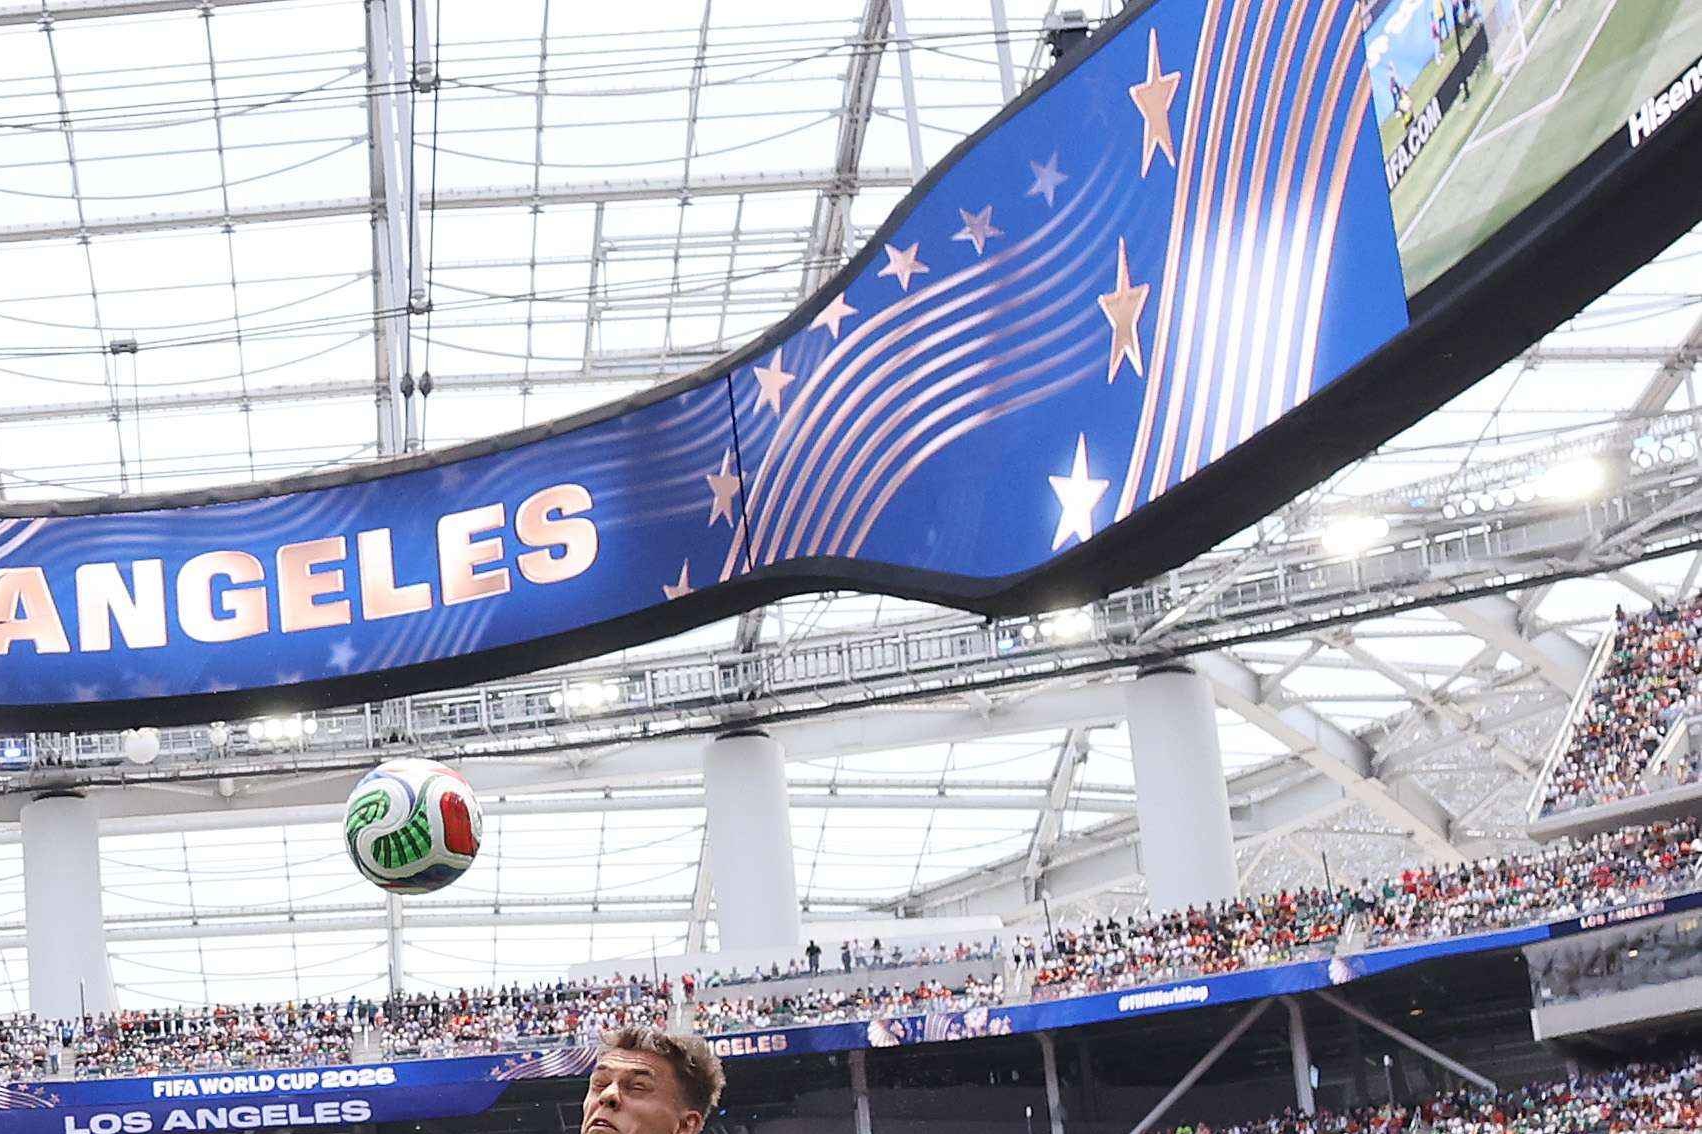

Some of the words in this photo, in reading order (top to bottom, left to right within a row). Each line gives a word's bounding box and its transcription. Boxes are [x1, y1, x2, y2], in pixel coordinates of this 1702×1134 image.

[152, 1080, 198, 1098] FIFA
[199, 1075, 276, 1096] WORLD
[277, 1071, 319, 1091] CUP
[320, 1068, 396, 1088] 2026
[162, 1100, 372, 1132] ANGELES
